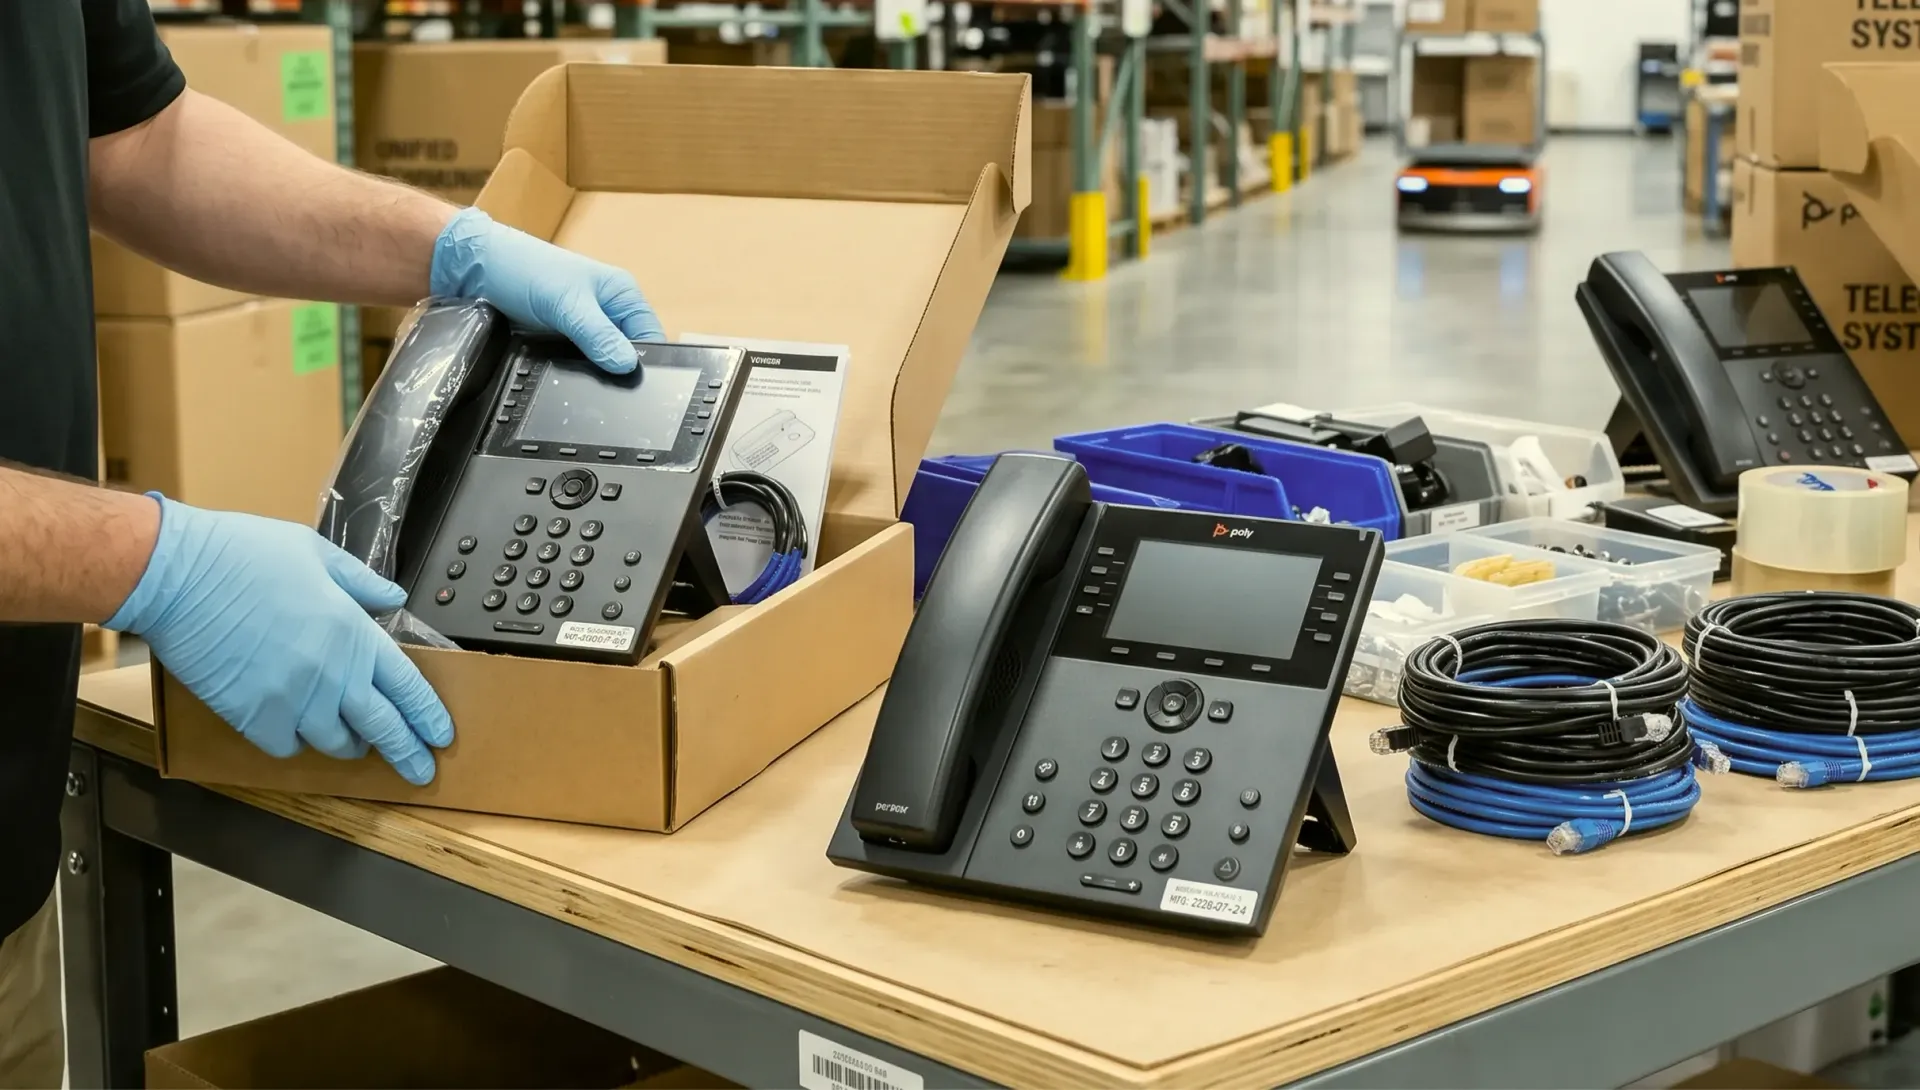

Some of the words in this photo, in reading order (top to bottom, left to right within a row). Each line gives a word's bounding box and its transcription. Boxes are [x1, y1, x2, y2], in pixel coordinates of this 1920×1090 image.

[1843, 283, 1920, 313] TELE
[1229, 527, 1255, 539] poly
[1149, 750, 1159, 760] 2
[1191, 756, 1201, 766] 3
[1138, 782, 1148, 792] 5
[1086, 808, 1096, 818] 7
[1127, 814, 1137, 825] 8
[1168, 820, 1179, 832] 9
[1116, 846, 1126, 857] 0
